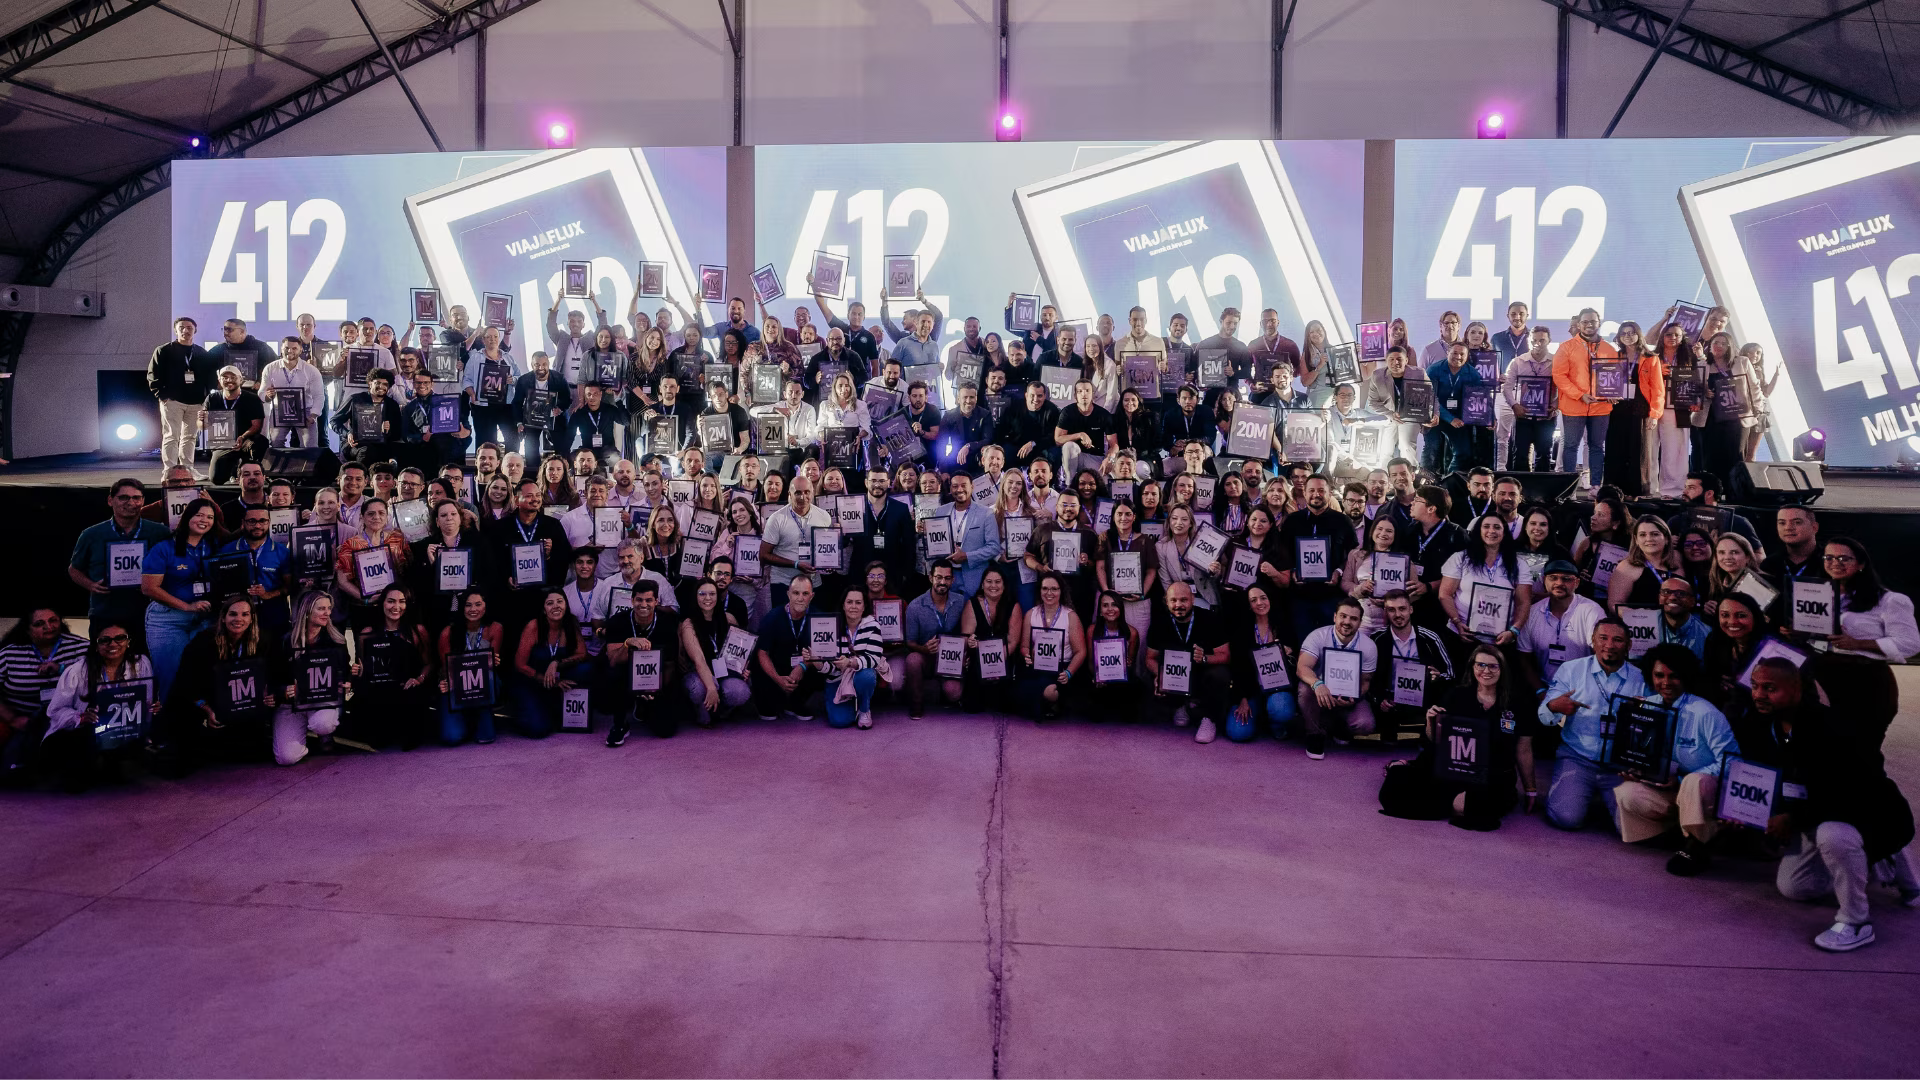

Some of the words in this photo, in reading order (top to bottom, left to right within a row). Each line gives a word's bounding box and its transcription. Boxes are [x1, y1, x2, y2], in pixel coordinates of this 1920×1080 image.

[505, 220, 585, 257] VIAJAFLUX
[1123, 215, 1209, 253] VIAJAFLUX
[1798, 214, 1895, 253] VIAJAFLUX
[199, 198, 348, 322] 412
[785, 187, 950, 318] 412
[1425, 185, 1607, 321] 412
[1018, 306, 1032, 320] 1M
[1364, 335, 1382, 350] 3M
[437, 355, 450, 370] 1M
[1204, 359, 1222, 374] 5M
[601, 364, 617, 378] 2M
[960, 364, 977, 379] 5M
[1477, 364, 1495, 379] 3M
[1599, 370, 1621, 387] 5M
[485, 377, 502, 391] 2M
[758, 376, 776, 391] 2M
[1524, 389, 1544, 404] 4M
[1467, 397, 1487, 412] 3M
[438, 406, 453, 421] 1M
[1861, 394, 1920, 446] MILH
[212, 422, 228, 437] 1M
[709, 426, 727, 442] 2M
[764, 425, 783, 441] 2M
[1237, 420, 1268, 440] 20M
[673, 492, 689, 502] 50K
[976, 485, 993, 500] 500K
[171, 503, 187, 516] 100
[842, 511, 861, 521] 500K
[600, 520, 618, 533] 50K
[1098, 514, 1112, 524] 250
[695, 522, 714, 535] 250K
[928, 531, 948, 542] 100K
[1011, 532, 1029, 543] 250K
[303, 542, 327, 564] 1M
[817, 543, 836, 554] 250K
[1055, 547, 1075, 558] 500K
[1196, 539, 1217, 555] 250K
[114, 555, 140, 571] 50K
[683, 553, 704, 565] 500K
[740, 550, 760, 561] 100K
[1303, 551, 1324, 565] 50K
[363, 563, 388, 578] 100K
[442, 565, 466, 576] 500K
[518, 558, 540, 570] 500K
[1233, 560, 1255, 576] 100K
[1598, 559, 1617, 573] 500
[1116, 567, 1136, 578] 250K
[1380, 569, 1403, 583] 100K
[1477, 600, 1502, 618] 50K
[1796, 600, 1829, 617] 500K
[878, 614, 899, 626] 500K
[812, 630, 835, 643] 250K
[726, 642, 747, 660] 500K
[940, 650, 961, 662] 500K
[981, 651, 1003, 665] 100K
[1037, 643, 1057, 658] 50K
[1100, 655, 1121, 667] 500K
[1259, 660, 1284, 676] 250K
[635, 663, 657, 676] 100K
[1165, 664, 1188, 677] 500K
[1329, 667, 1354, 681] 500K
[306, 666, 332, 690] 1M
[459, 668, 484, 691] 1M
[1397, 676, 1422, 691] 500K
[228, 676, 256, 701] 1M
[107, 700, 142, 728] 2M
[566, 699, 586, 714] 50K
[1448, 735, 1477, 763] 1M
[1729, 780, 1769, 807] 500K
